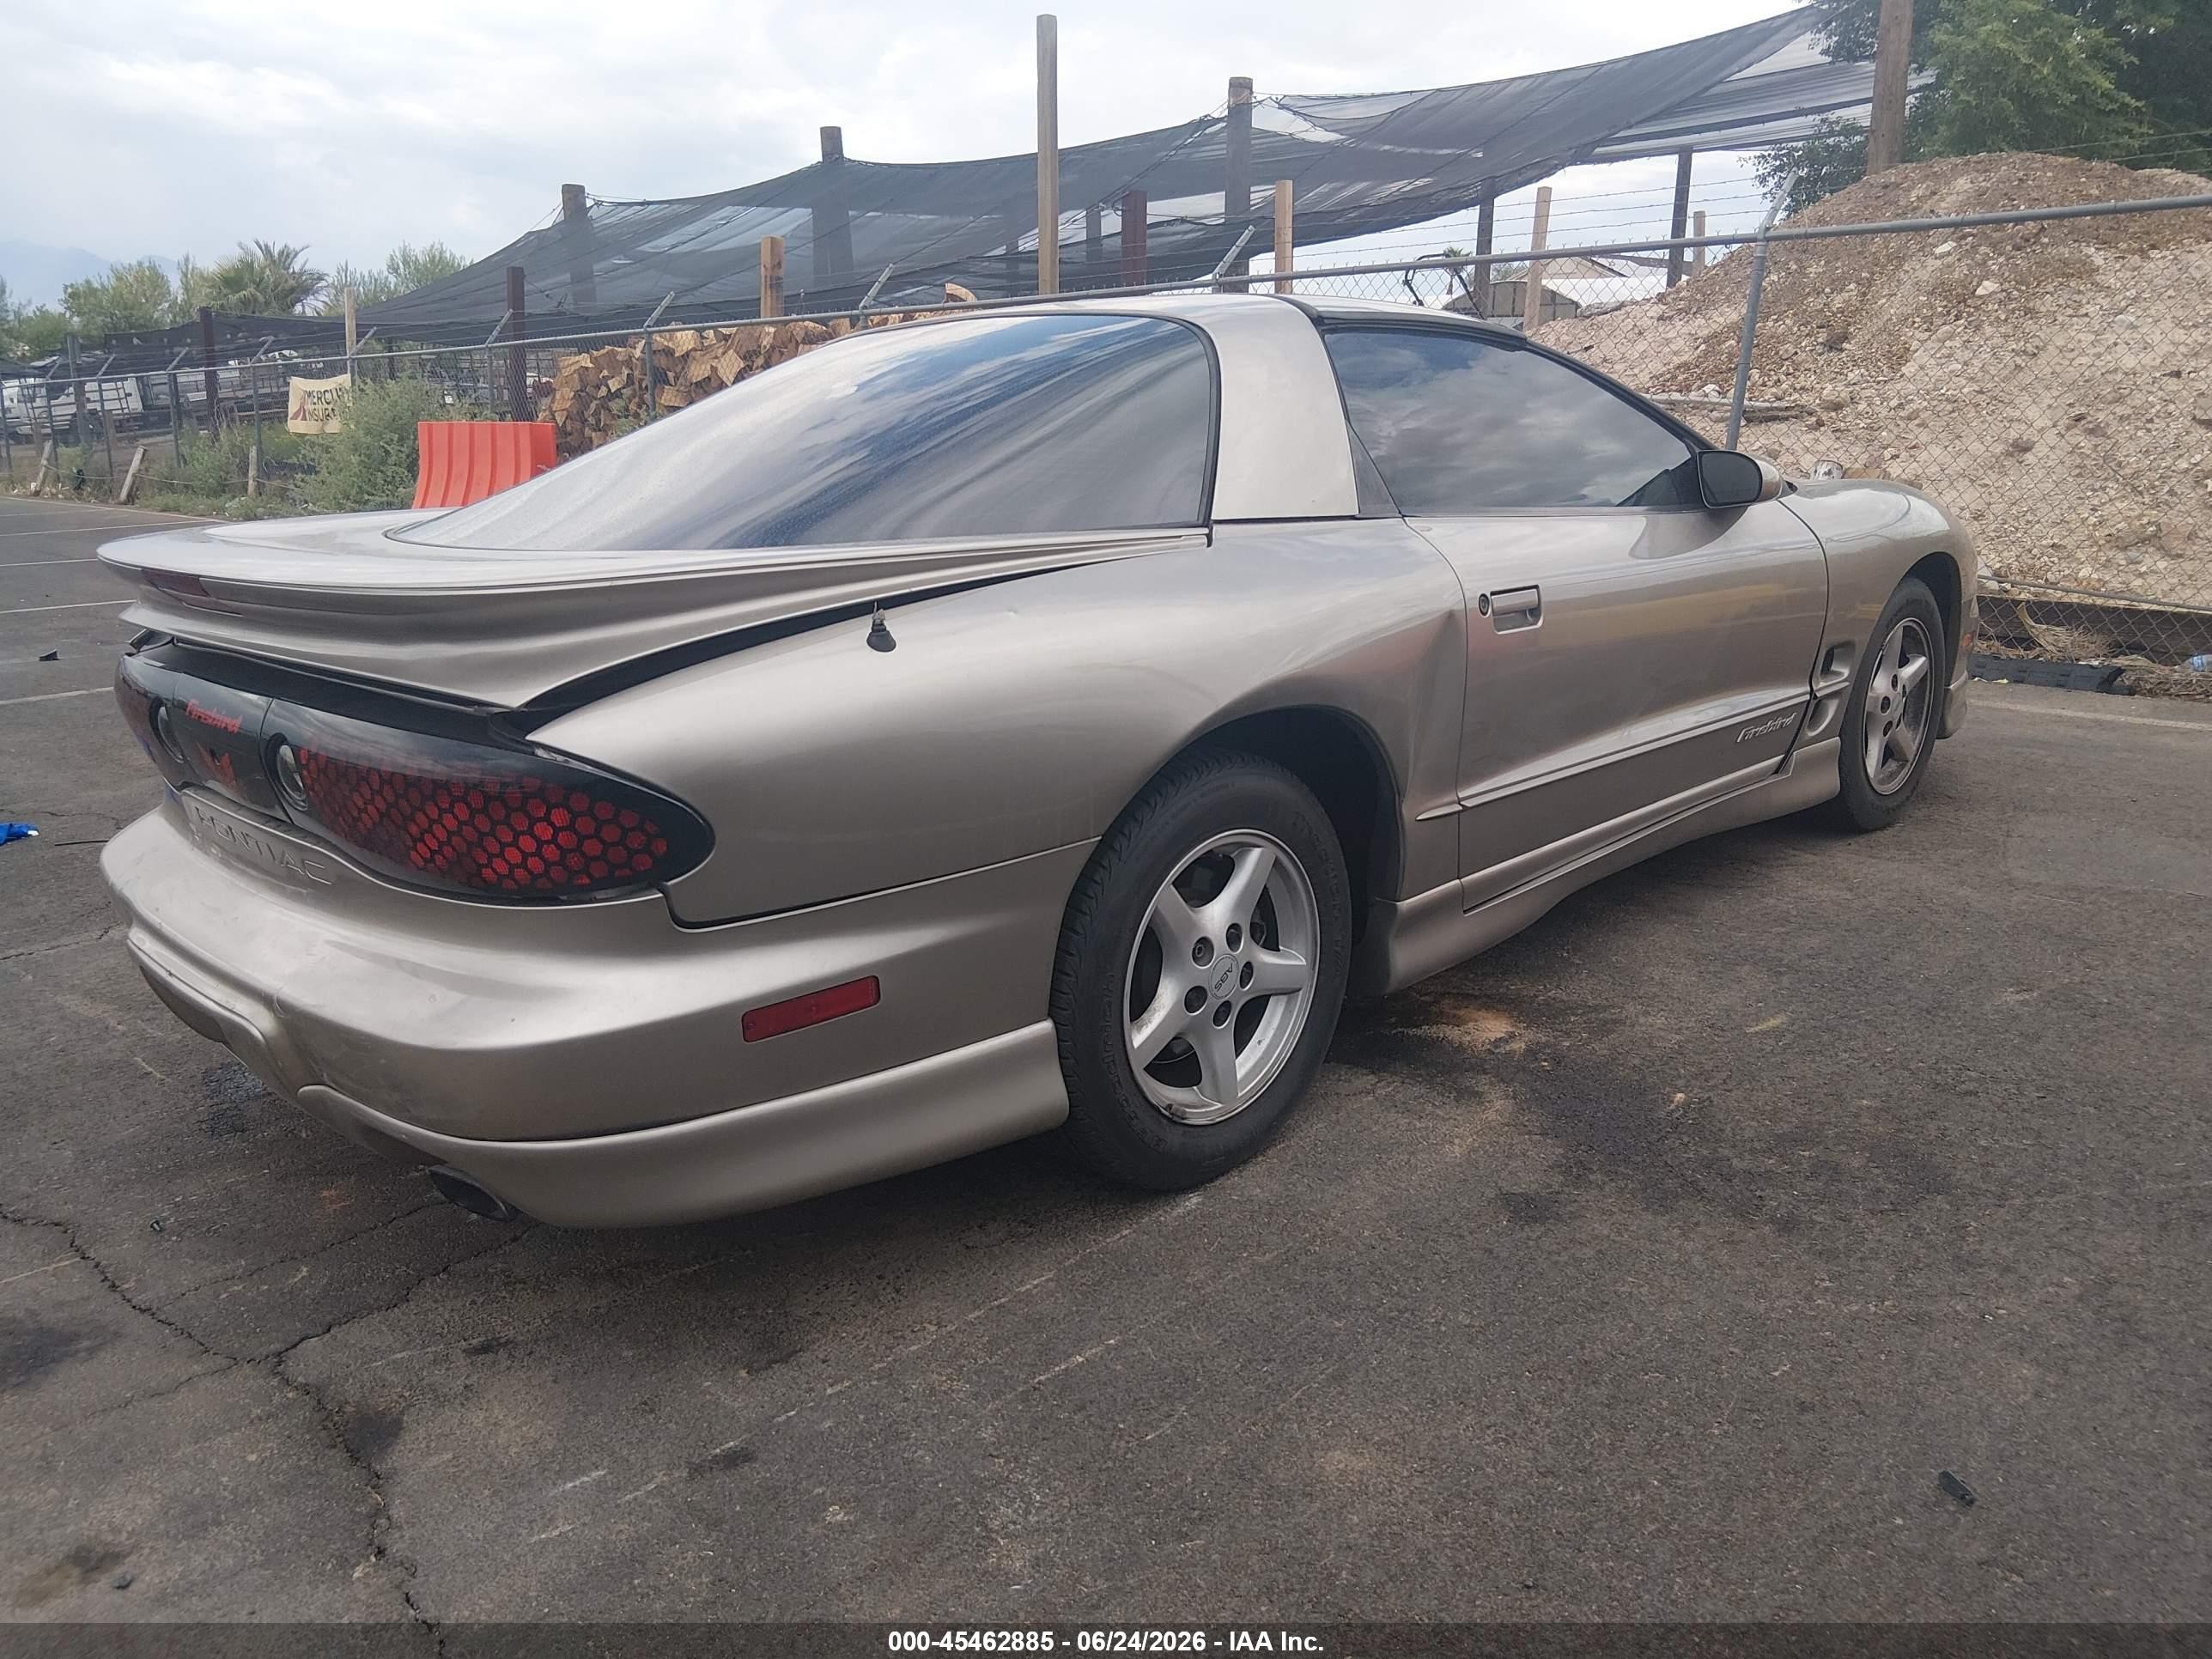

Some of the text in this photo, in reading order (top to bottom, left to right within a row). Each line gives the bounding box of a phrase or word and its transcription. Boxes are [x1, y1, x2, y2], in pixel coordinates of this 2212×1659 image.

[1735, 712, 1798, 743] Firebird
[194, 805, 333, 886] PONTIAC
[1214, 962, 1233, 993] ABS
